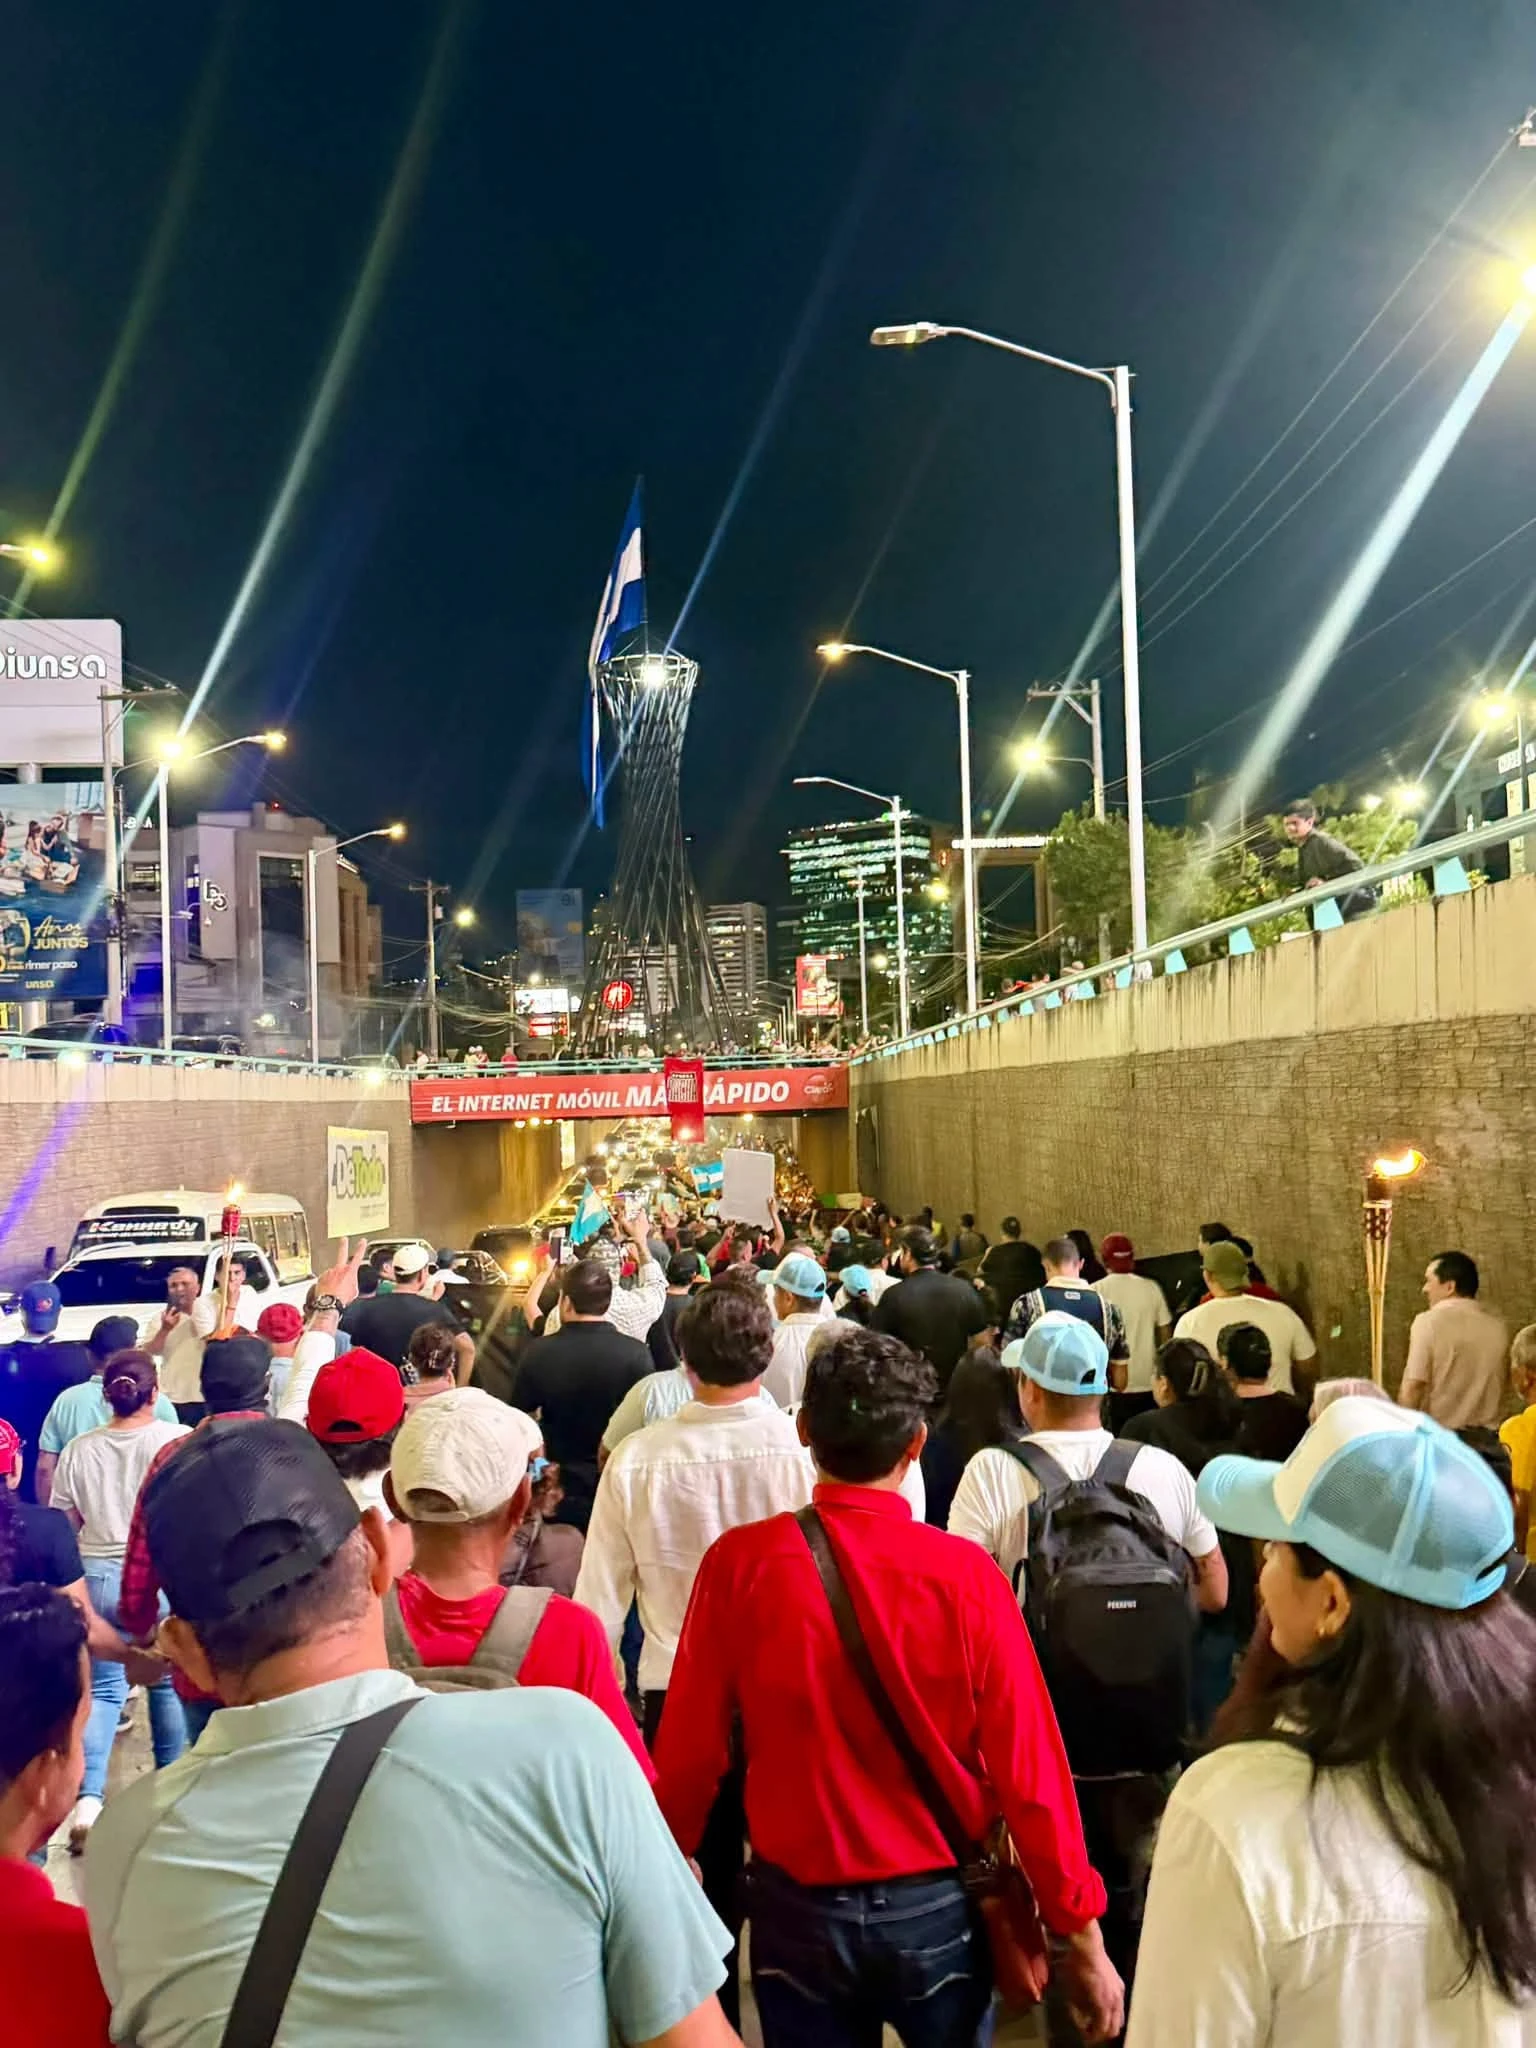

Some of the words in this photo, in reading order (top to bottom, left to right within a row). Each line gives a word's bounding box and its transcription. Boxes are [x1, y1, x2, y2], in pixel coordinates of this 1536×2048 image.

[33, 937, 89, 951] JUNTOS
[431, 1096, 454, 1113] EL
[458, 1093, 553, 1112] INTERNET
[556, 1088, 621, 1110] MÓVIL
[624, 1080, 668, 1107] MÁ
